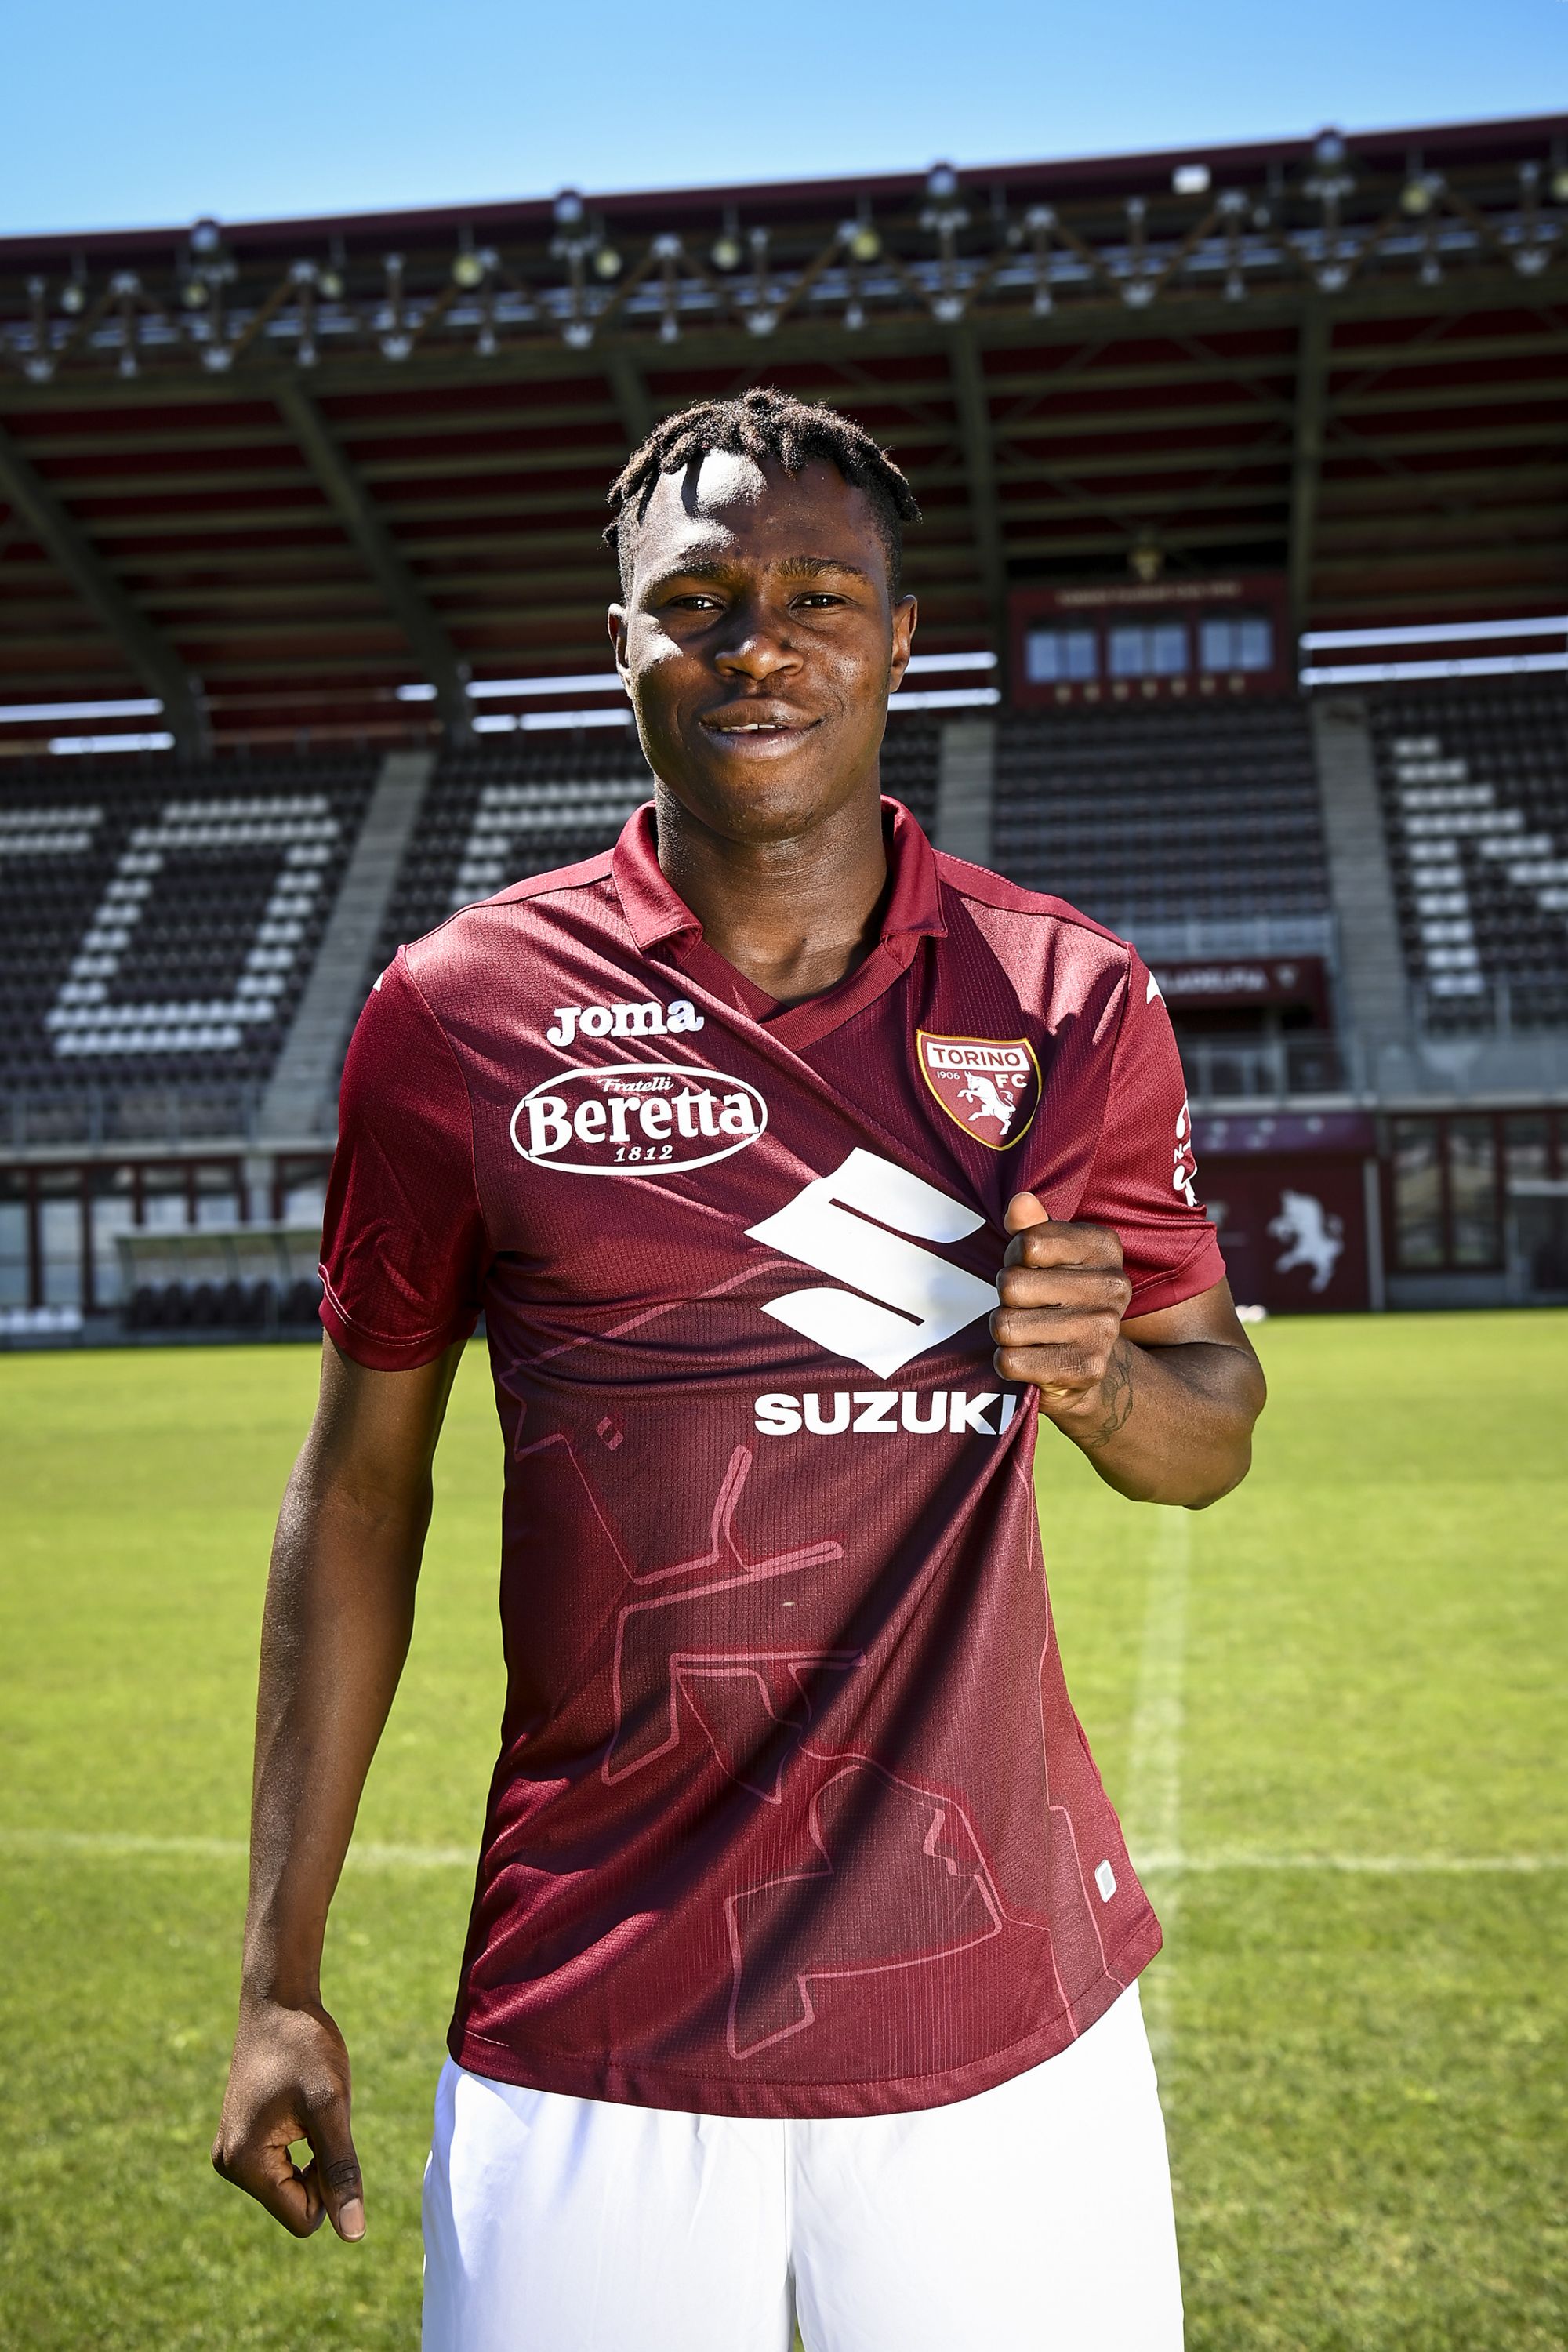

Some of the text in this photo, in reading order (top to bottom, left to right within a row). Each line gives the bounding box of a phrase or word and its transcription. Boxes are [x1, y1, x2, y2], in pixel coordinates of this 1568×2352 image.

[546, 1000, 704, 1047] Joma
[932, 1047, 1021, 1067] TORINO
[597, 1076, 674, 1093] Fratelli
[936, 1070, 961, 1080] 1906
[994, 1073, 1028, 1089] FC
[524, 1087, 760, 1158] Beretta
[613, 1144, 673, 1163] 1812
[754, 1391, 1018, 1436] SUZUKI
